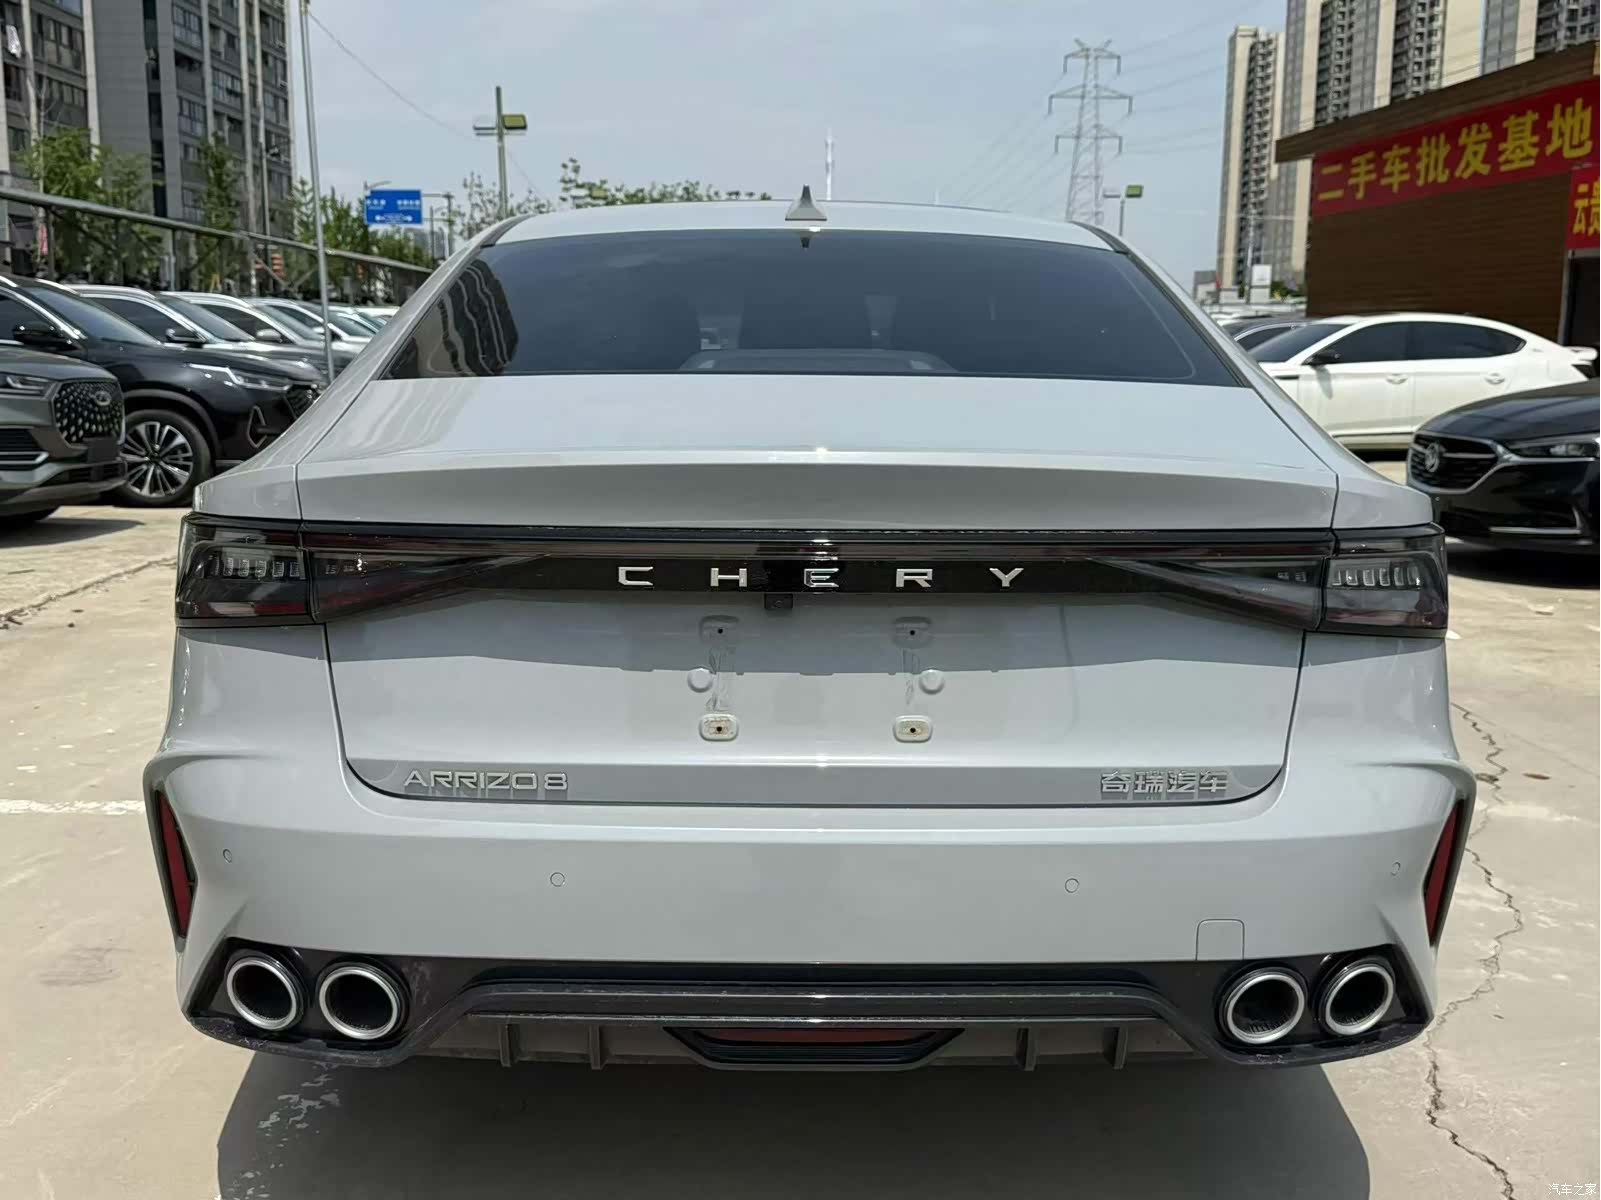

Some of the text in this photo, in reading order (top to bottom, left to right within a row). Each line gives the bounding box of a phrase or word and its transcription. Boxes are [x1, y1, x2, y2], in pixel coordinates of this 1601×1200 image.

[1317, 97, 1594, 200] 二手车批发基地
[617, 565, 1025, 588] CHERY
[403, 770, 568, 790] ARRIZO 8
[1101, 770, 1230, 793] 奇瑞汽车
